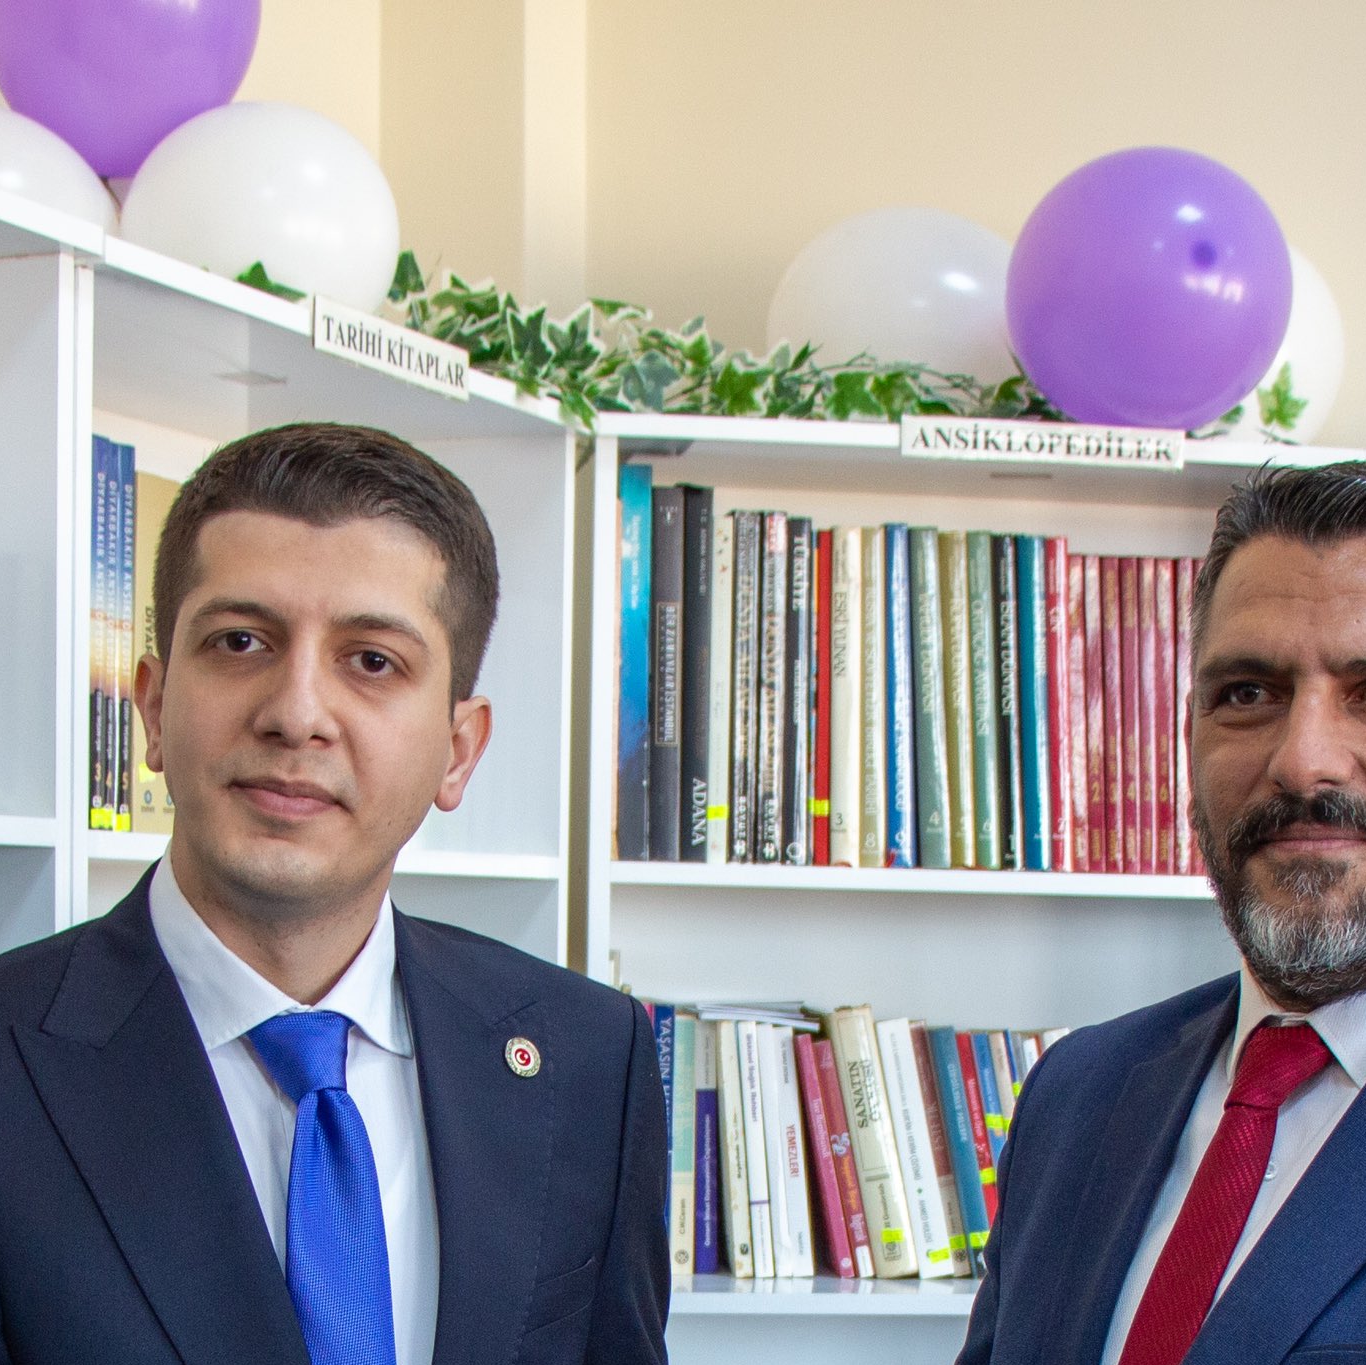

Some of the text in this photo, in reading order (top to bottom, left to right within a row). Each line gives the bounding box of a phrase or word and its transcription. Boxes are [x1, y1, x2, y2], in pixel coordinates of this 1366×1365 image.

[322, 314, 465, 389] TARİHİ KİTAPLAR
[911, 424, 1175, 463] ANSİKLOPEDİLER
[834, 592, 848, 678] ESKİ YUNAN
[691, 777, 707, 846] ADANA
[658, 1017, 673, 1080] YAŞASIN
[847, 1061, 869, 1129] SANATIN
[786, 1124, 799, 1177] YEMEZLER!
